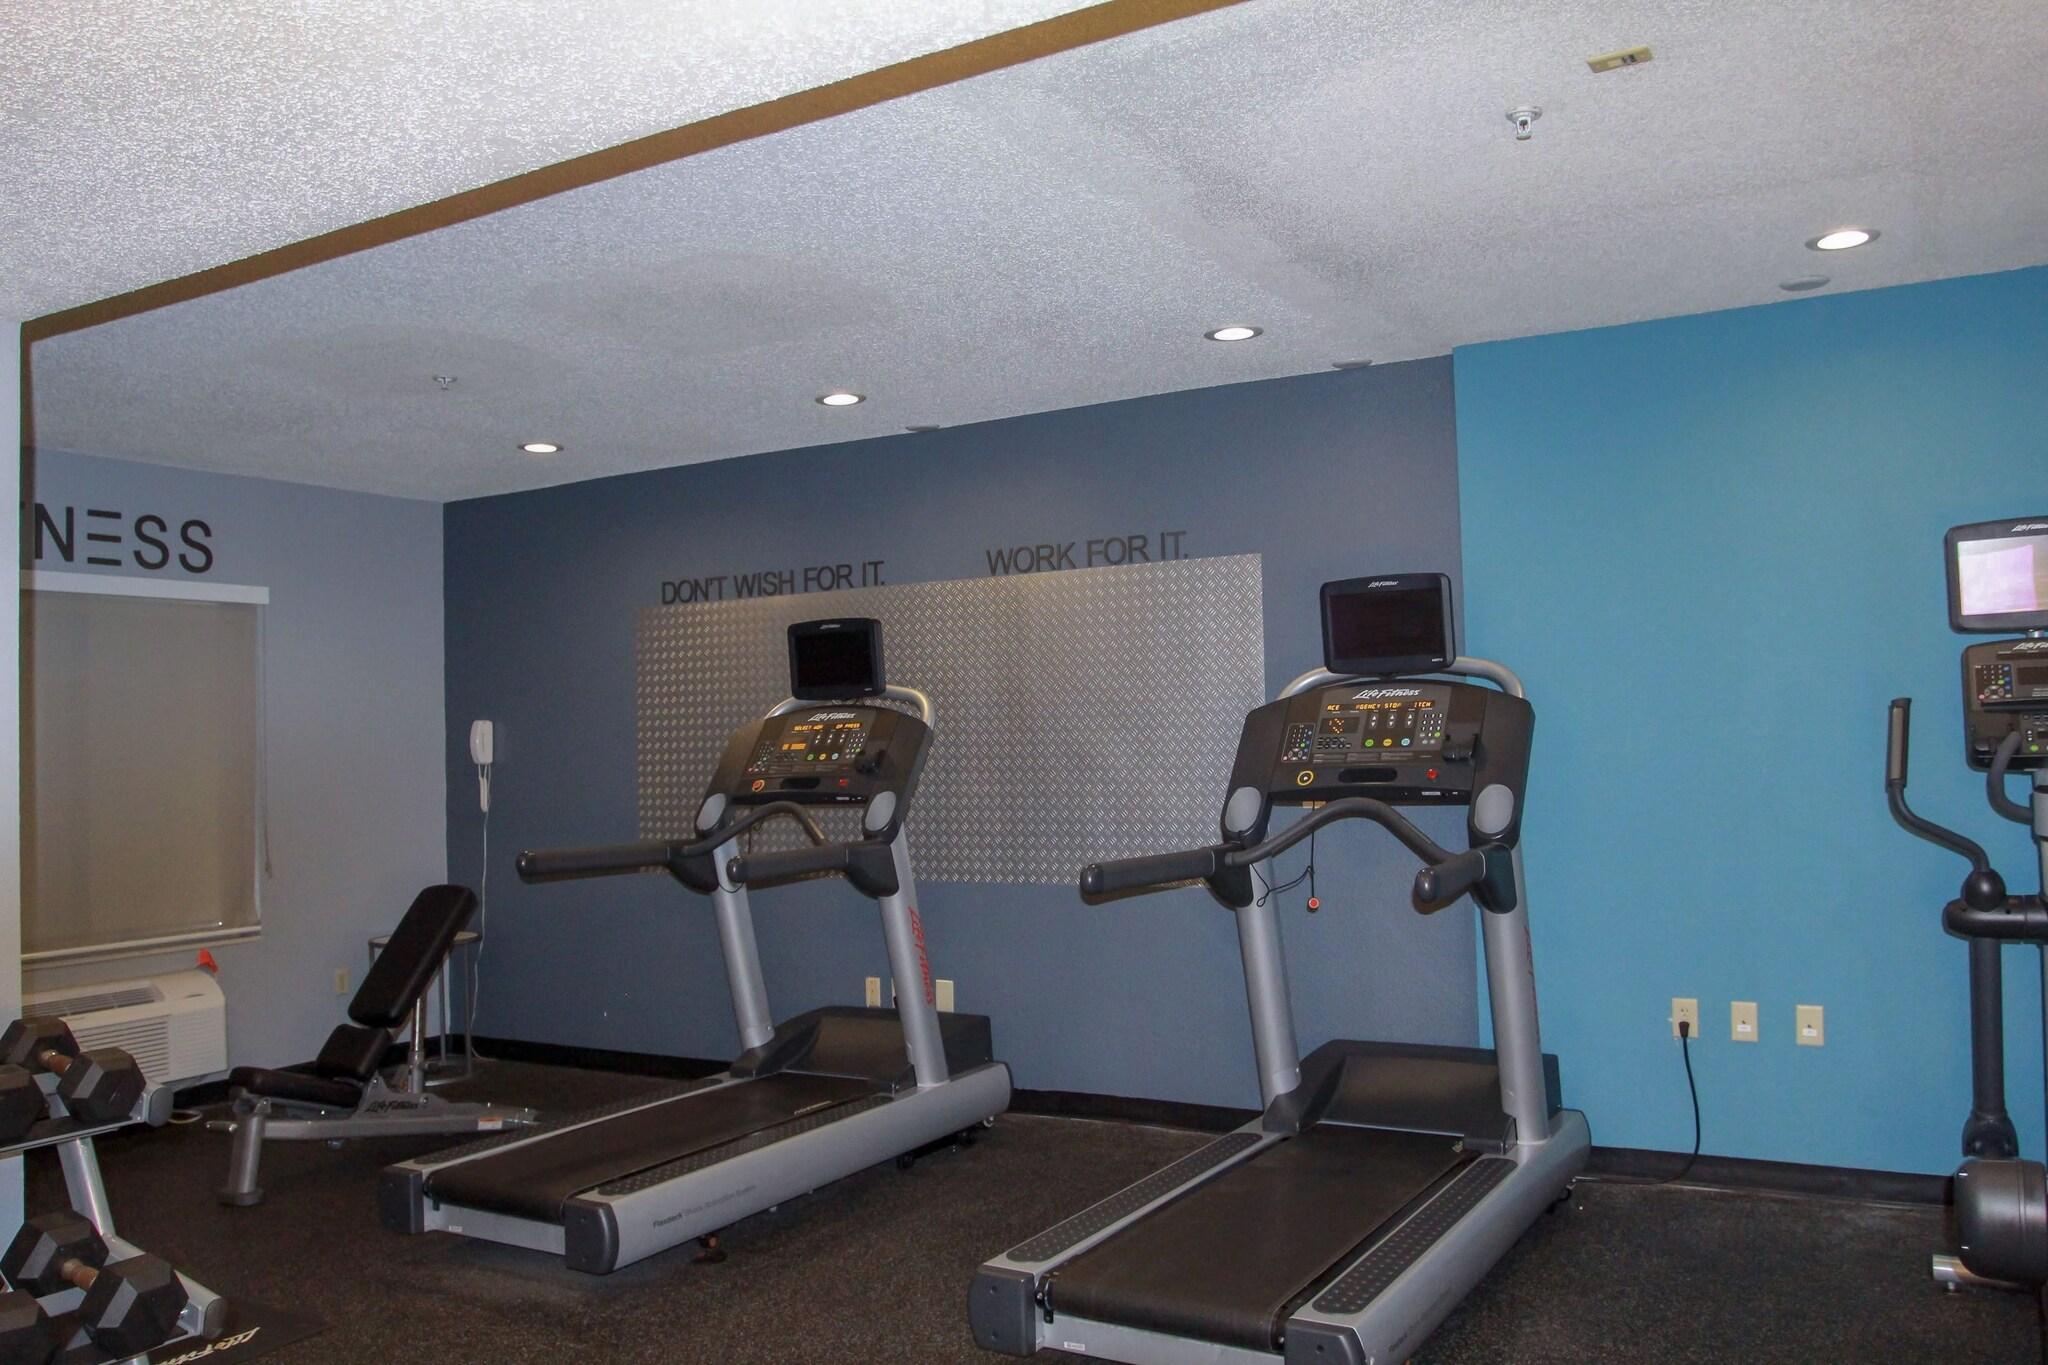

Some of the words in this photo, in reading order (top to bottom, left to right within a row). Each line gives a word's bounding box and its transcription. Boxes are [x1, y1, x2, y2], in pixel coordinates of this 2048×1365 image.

[34, 502, 214, 574] NESS
[985, 541, 1077, 577] WORK
[1086, 534, 1150, 568] FOR
[1160, 531, 1189, 561] IT.
[733, 570, 795, 599] WISH
[803, 564, 853, 593] FOR
[861, 560, 885, 588] IT.
